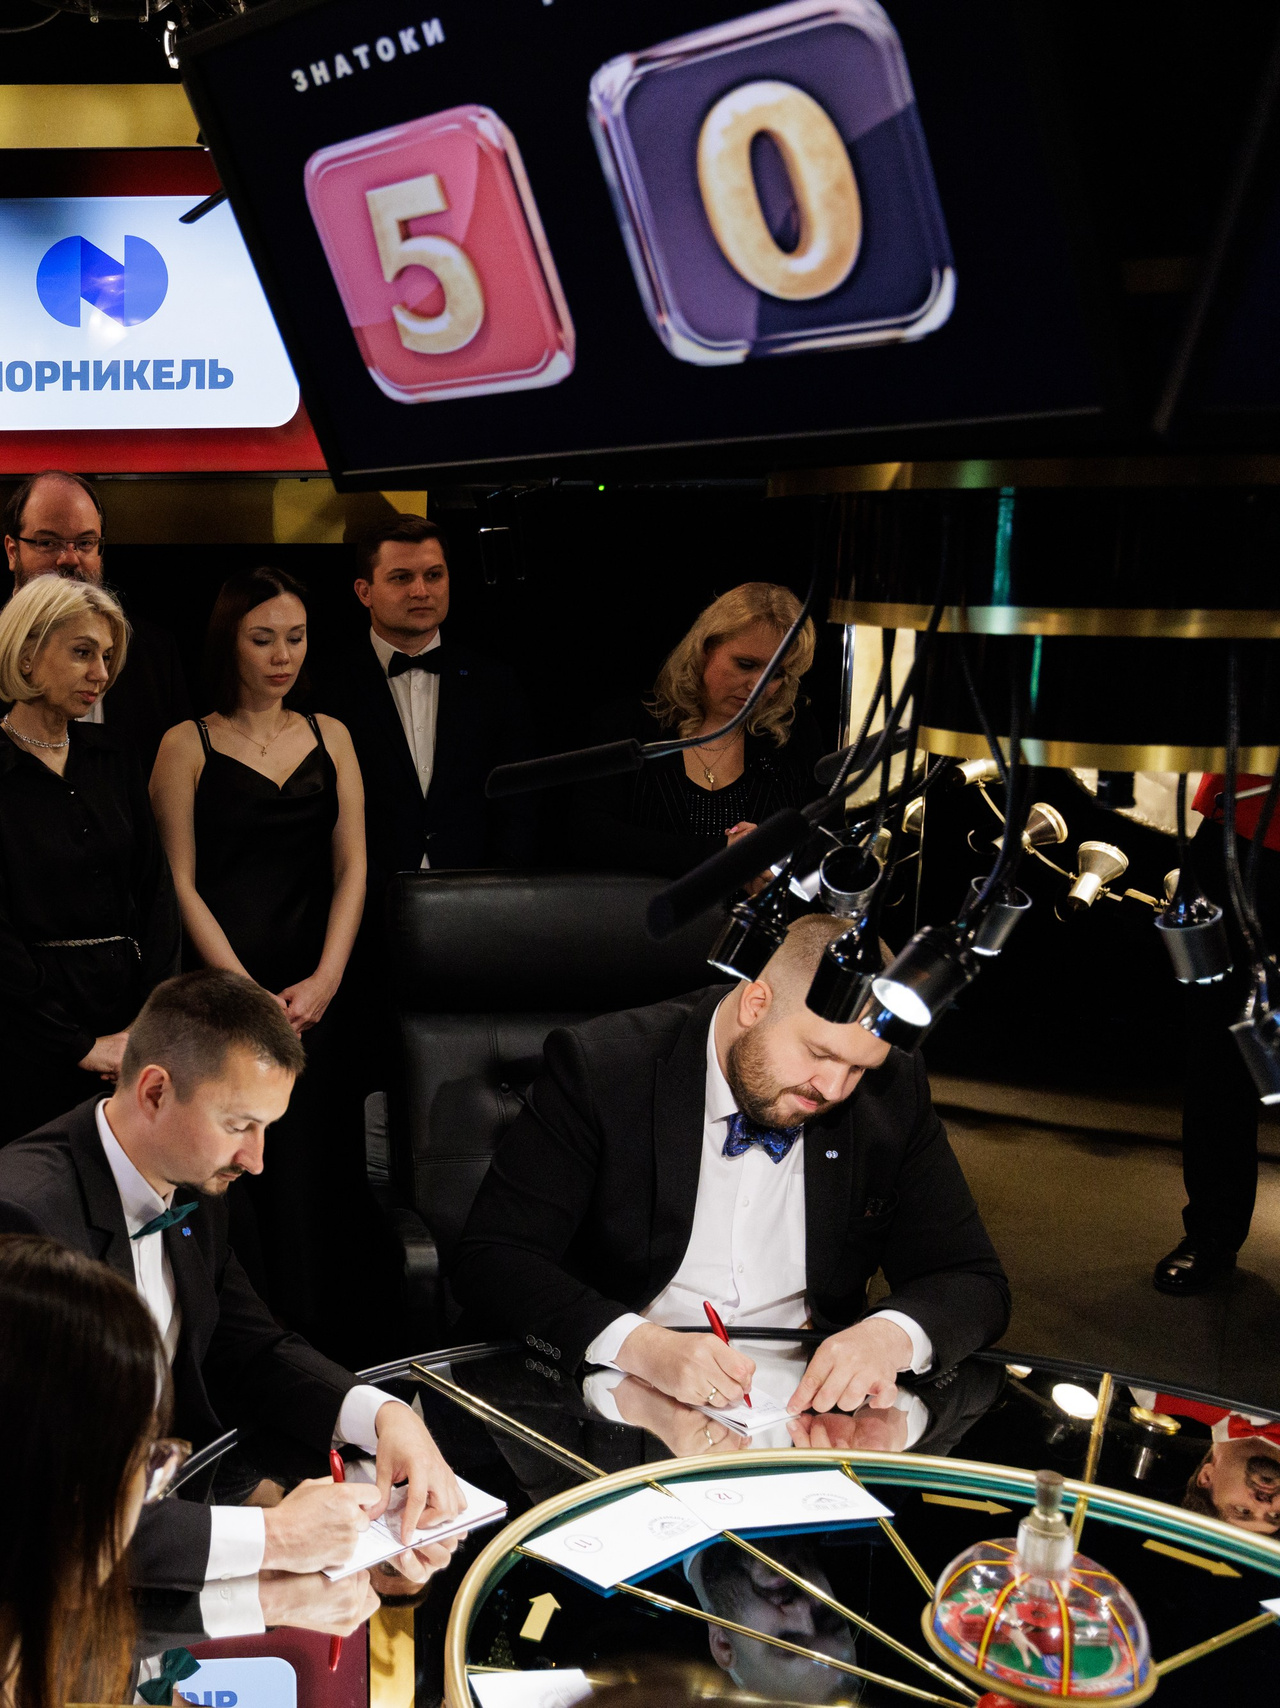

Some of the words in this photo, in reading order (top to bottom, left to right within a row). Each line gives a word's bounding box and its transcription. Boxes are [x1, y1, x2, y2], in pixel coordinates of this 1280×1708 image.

[291, 18, 446, 92] ЗНАТОКИ
[366, 173, 486, 355] 5
[697, 80, 863, 300] 0
[714, 1492, 733, 1501] 12
